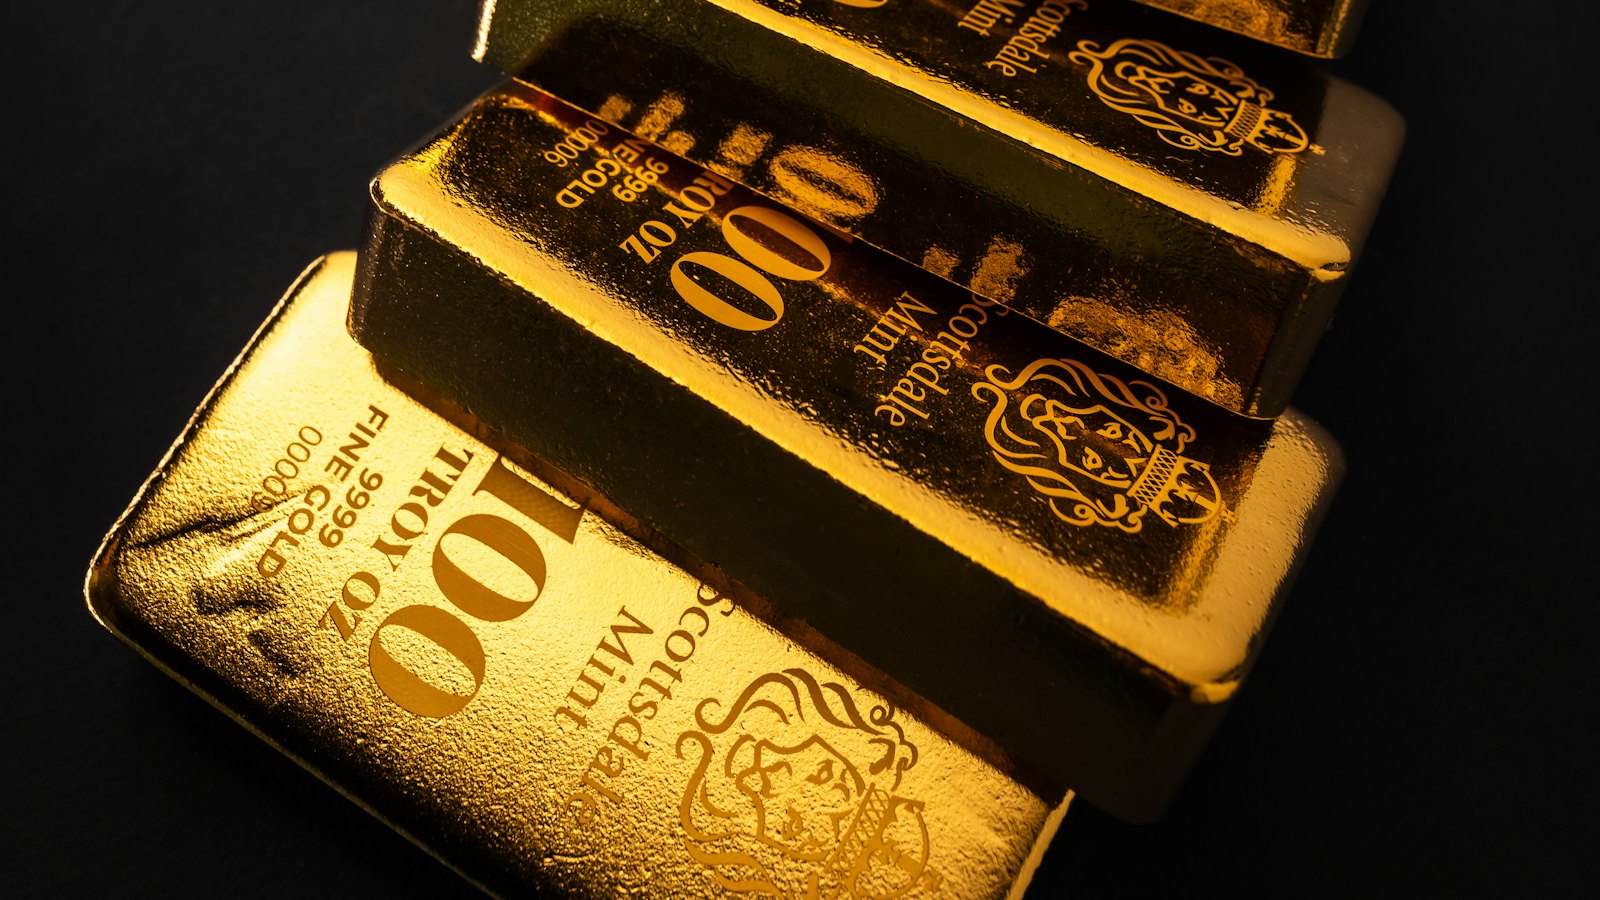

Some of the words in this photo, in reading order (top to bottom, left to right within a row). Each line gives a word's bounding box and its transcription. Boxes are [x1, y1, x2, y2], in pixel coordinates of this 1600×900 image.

[544, 119, 609, 168] 00006
[612, 157, 669, 202] 9999
[555, 158, 621, 208] GOLD
[662, 169, 734, 229] ROY
[618, 220, 677, 265] OZ
[670, 205, 853, 331] 00
[853, 290, 938, 365] Mint
[324, 405, 389, 482] FINE
[257, 485, 331, 578] GOLD
[318, 468, 383, 548] 9999
[371, 444, 474, 572] TROY
[318, 571, 381, 642] OZ
[369, 453, 587, 718] 100
[554, 605, 654, 730] Mint
[564, 580, 736, 825] Scottsdale
